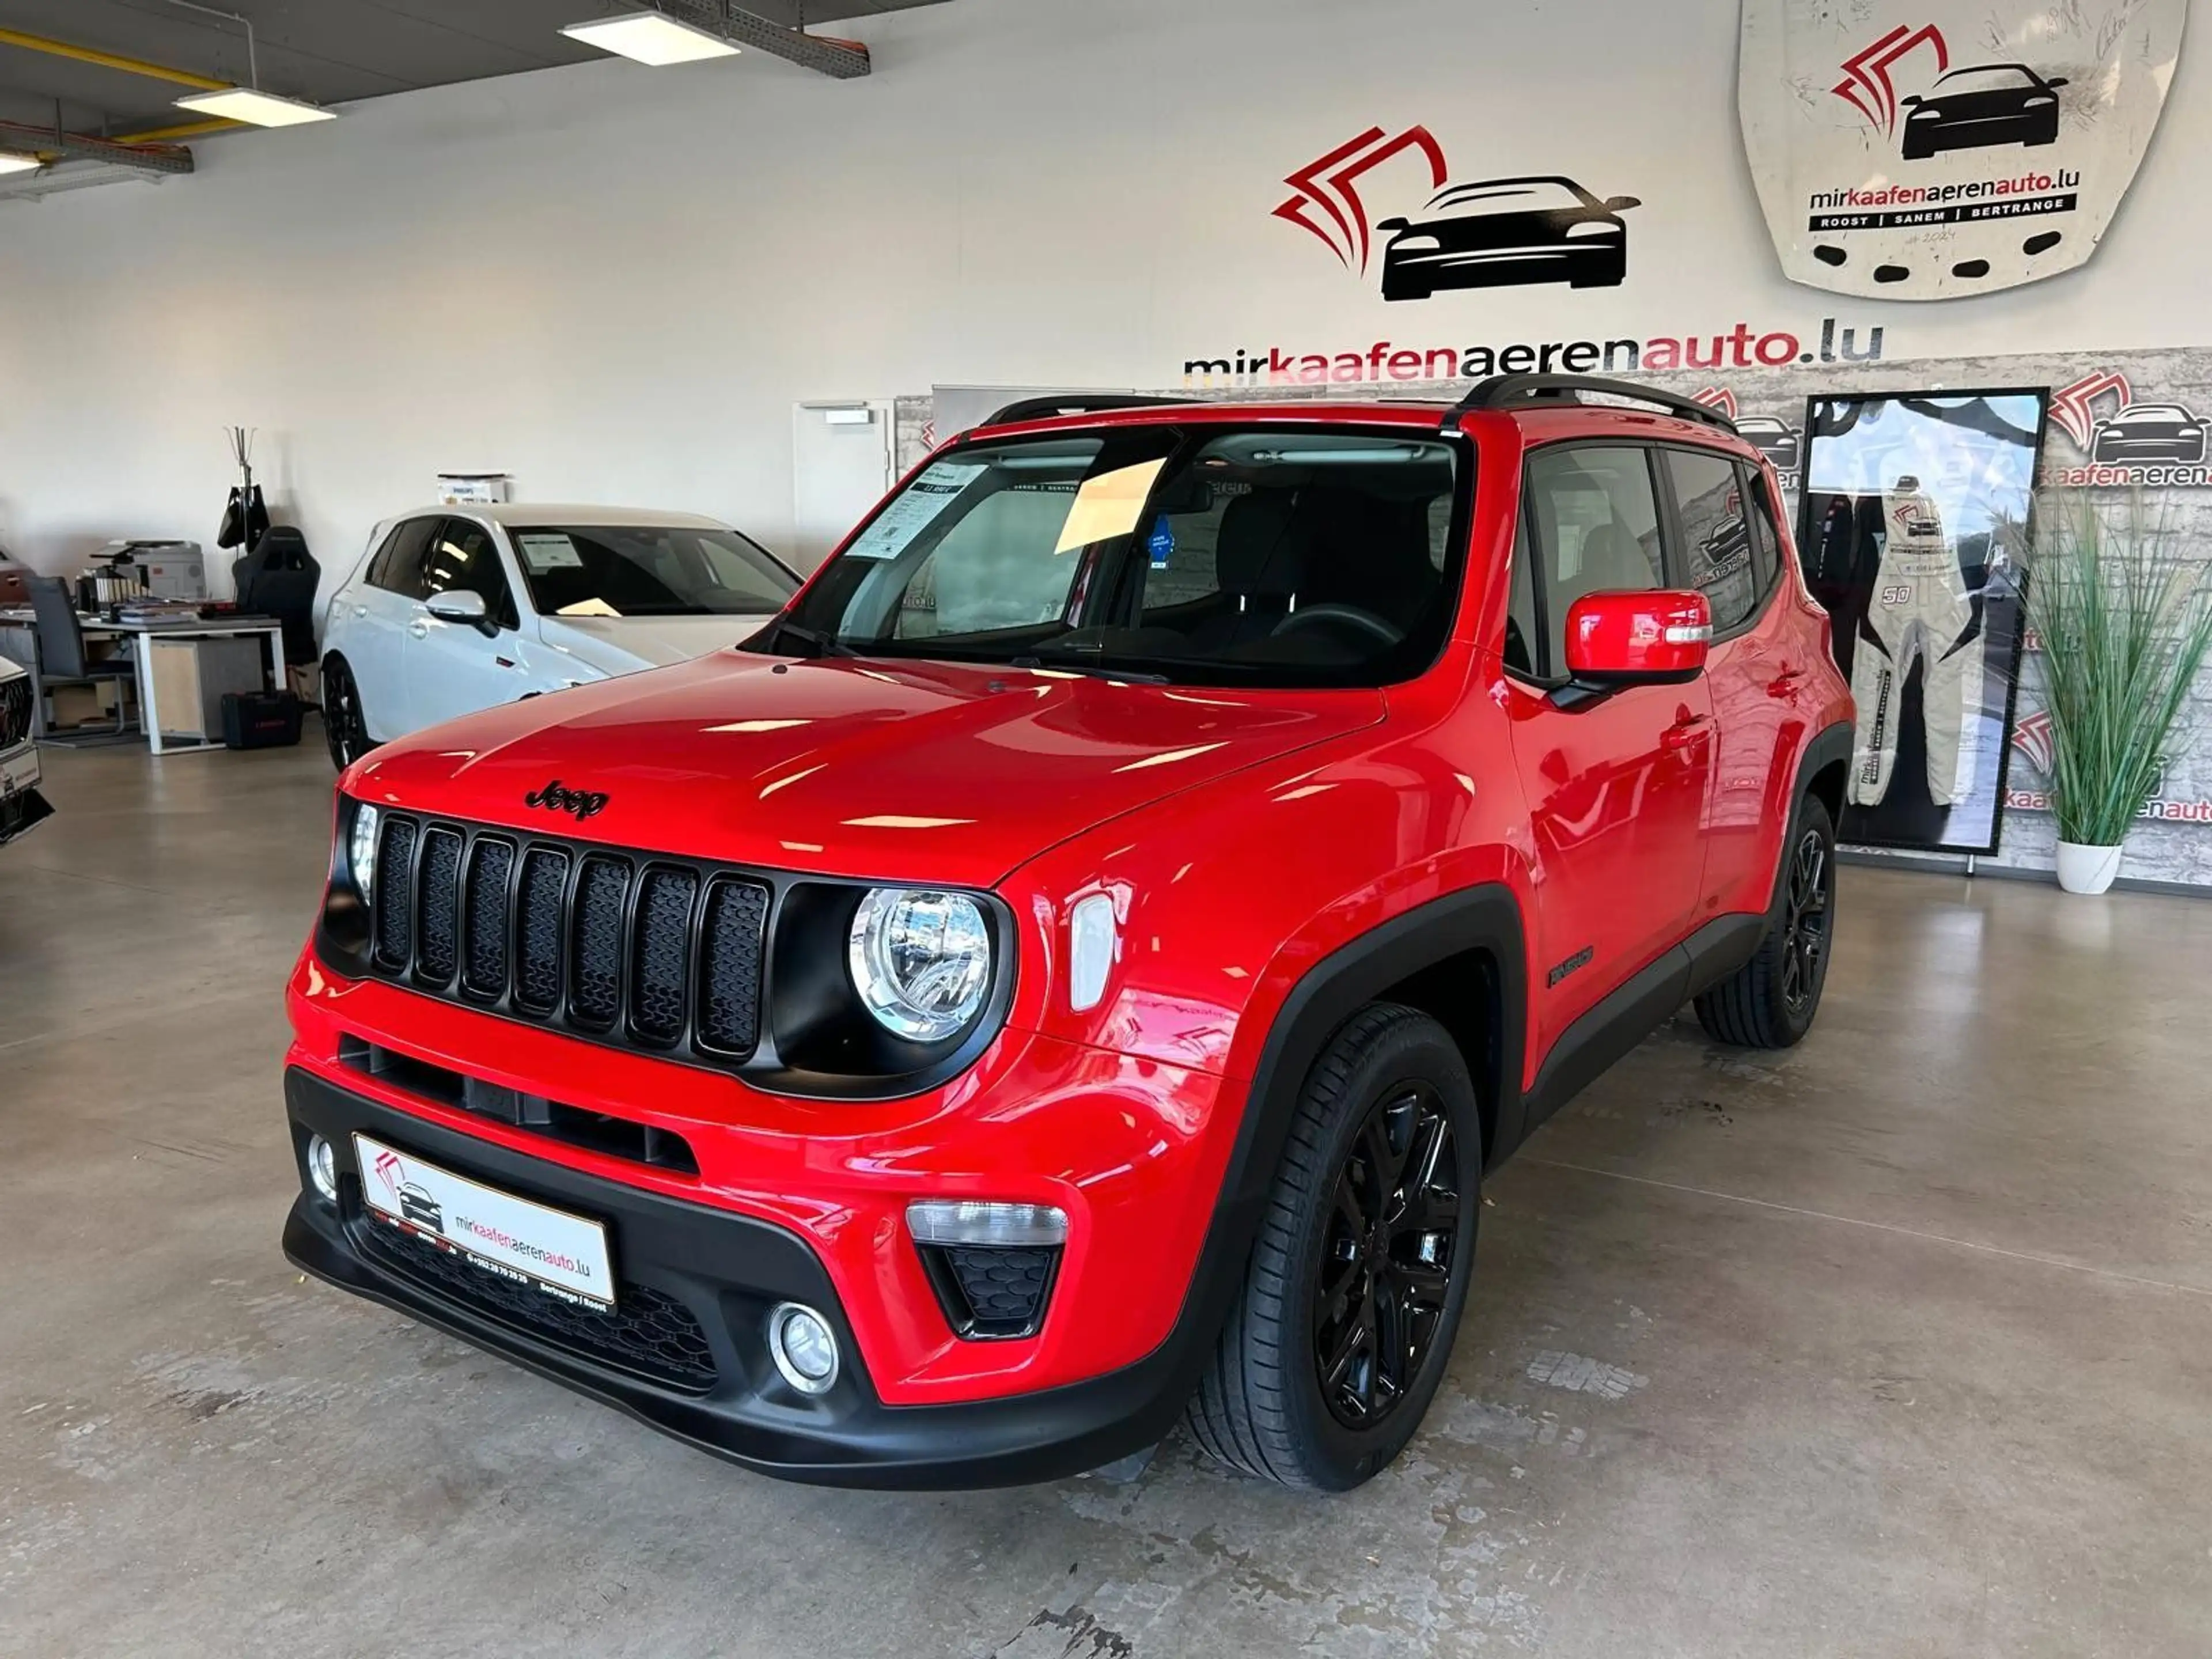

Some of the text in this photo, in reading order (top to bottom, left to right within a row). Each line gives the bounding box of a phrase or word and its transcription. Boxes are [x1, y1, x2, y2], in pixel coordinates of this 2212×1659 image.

[1810, 169, 2080, 209] mirkaafenaerenauto.lu
[1821, 217, 1868, 228] ROOST
[1894, 211, 1945, 224] SANEM
[1971, 198, 2065, 218] BERTRANGE
[1184, 318, 1884, 389] mirkaafenaerenauto.lu
[2039, 464, 2212, 485] kaafenaeren
[1883, 586, 1911, 604] 50
[524, 779, 610, 821] Jeep
[456, 1215, 590, 1277] mirkaafenaerenauto.lu
